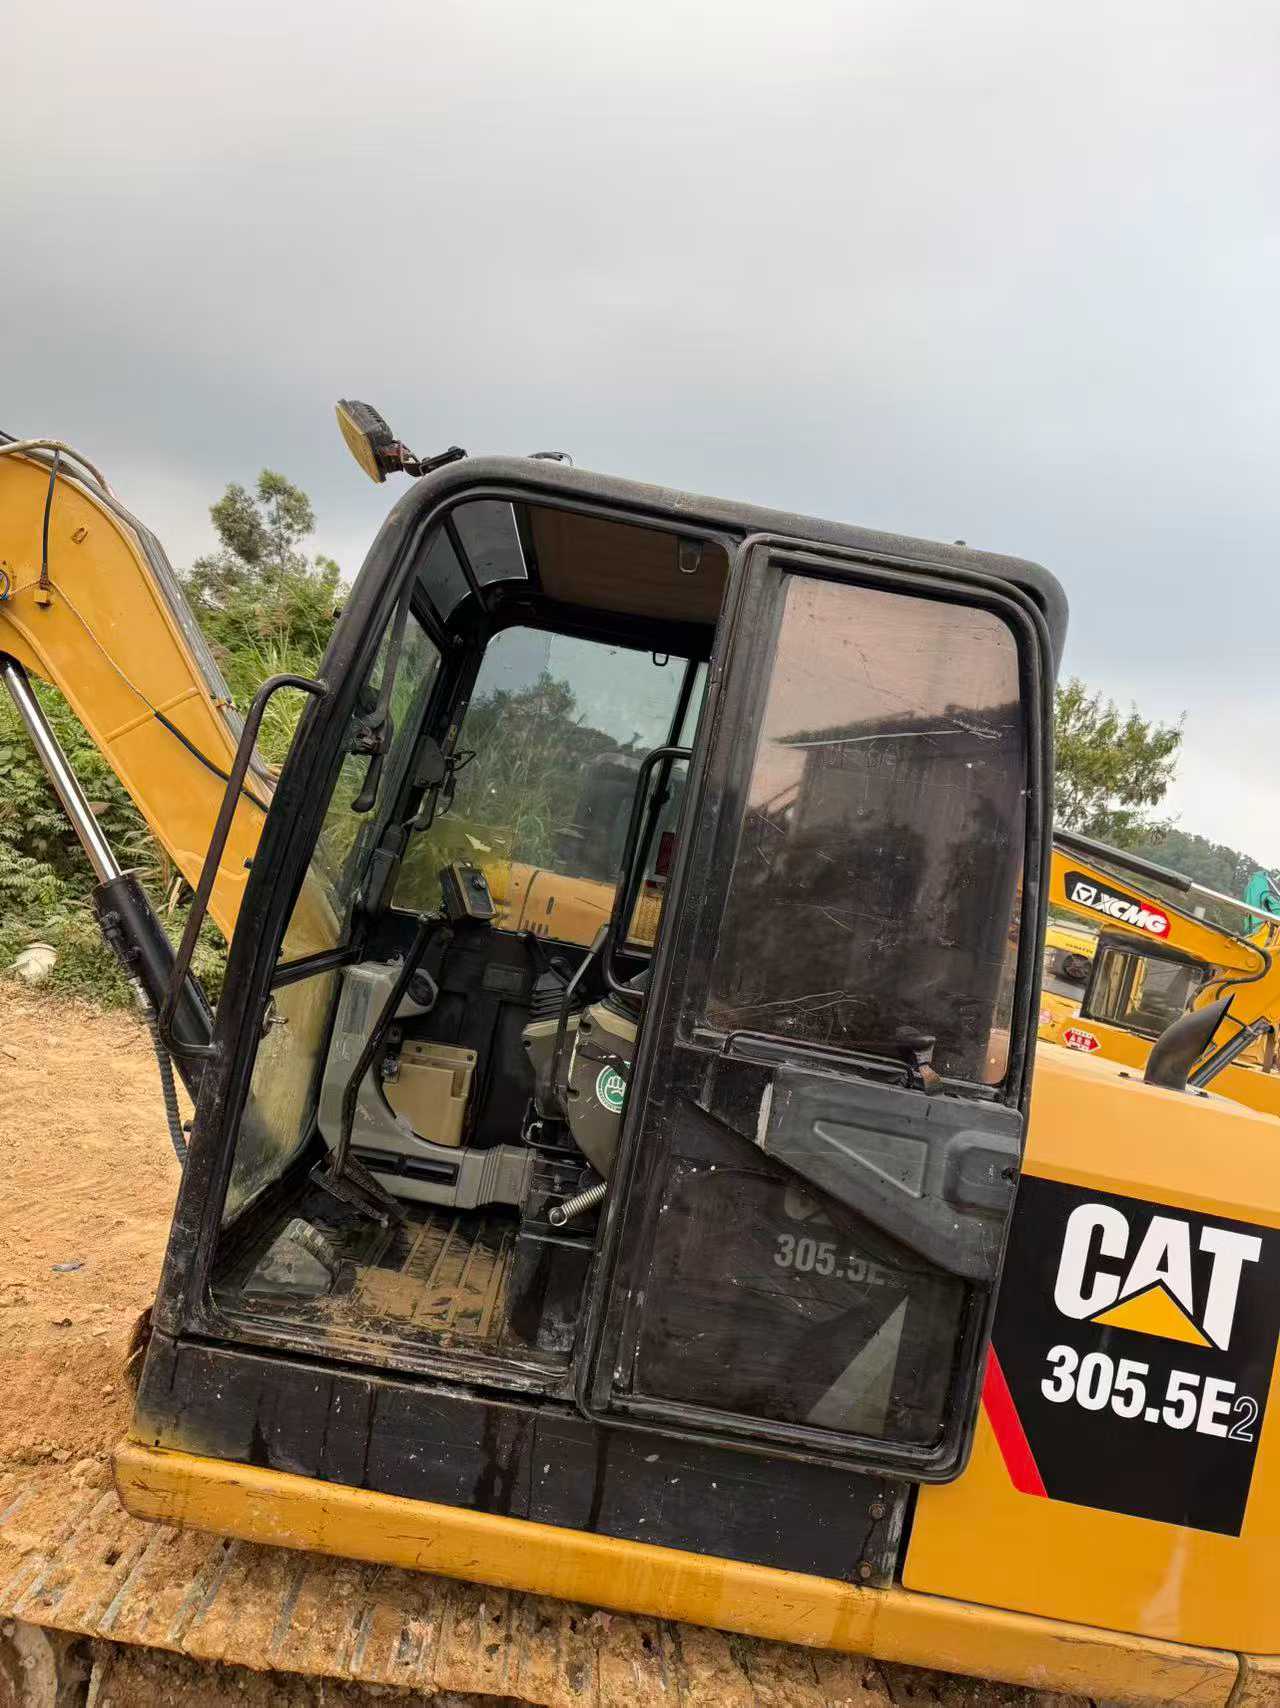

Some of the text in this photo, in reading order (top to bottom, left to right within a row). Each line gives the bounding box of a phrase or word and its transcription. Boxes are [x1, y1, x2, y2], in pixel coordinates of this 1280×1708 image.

[1094, 892, 1168, 933] XCMG
[1054, 1203, 1262, 1351] CAT
[1041, 1344, 1259, 1443] 305.5E2
